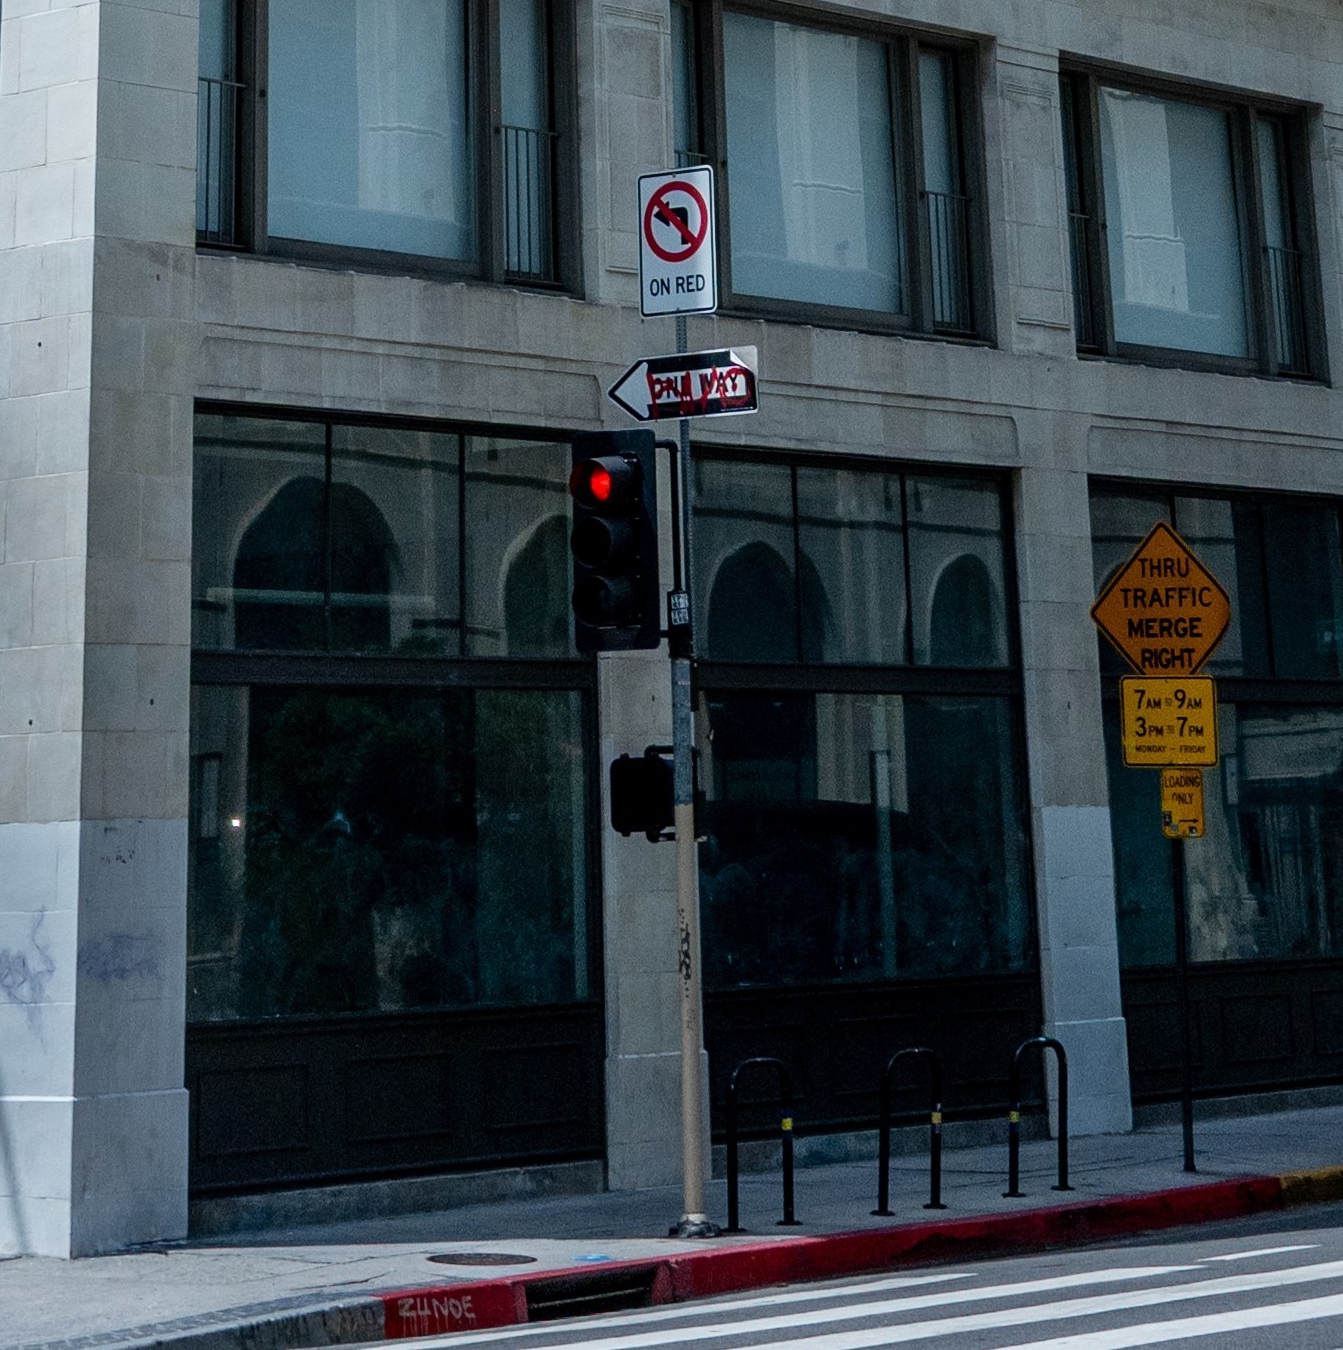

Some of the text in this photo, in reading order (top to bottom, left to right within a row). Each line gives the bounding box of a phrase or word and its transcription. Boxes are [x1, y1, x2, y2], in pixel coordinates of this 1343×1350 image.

[650, 274, 706, 297] ON RED
[1137, 557, 1190, 578] THRU
[1119, 586, 1212, 609] TRAFFIC
[1126, 617, 1203, 638] MERGE
[1140, 648, 1196, 670] RIGHT
[1135, 745, 1167, 754] MONDAY
[1179, 745, 1207, 754] FRIDAY
[1164, 775, 1202, 790] LOADING
